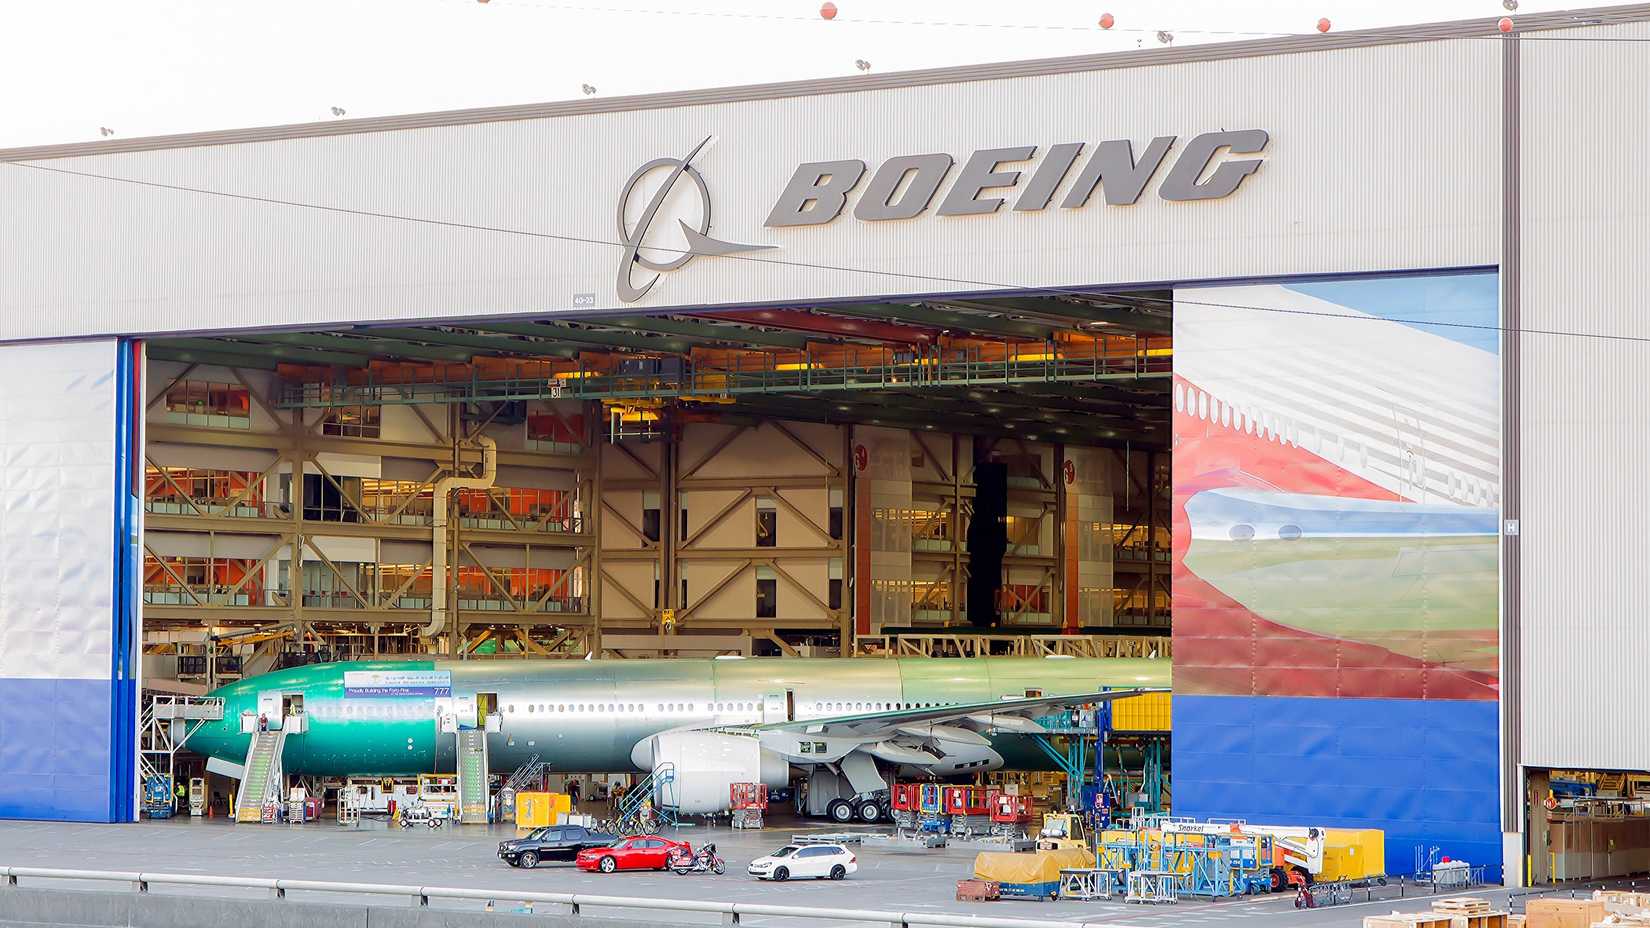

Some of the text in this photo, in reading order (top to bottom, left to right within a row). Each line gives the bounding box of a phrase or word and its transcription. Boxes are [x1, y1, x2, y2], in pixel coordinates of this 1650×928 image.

[764, 129, 1270, 227] BOEING
[552, 387, 560, 398] 31
[1508, 523, 1514, 532] H
[433, 688, 449, 696] 777
[1178, 824, 1204, 832] Snorkel
